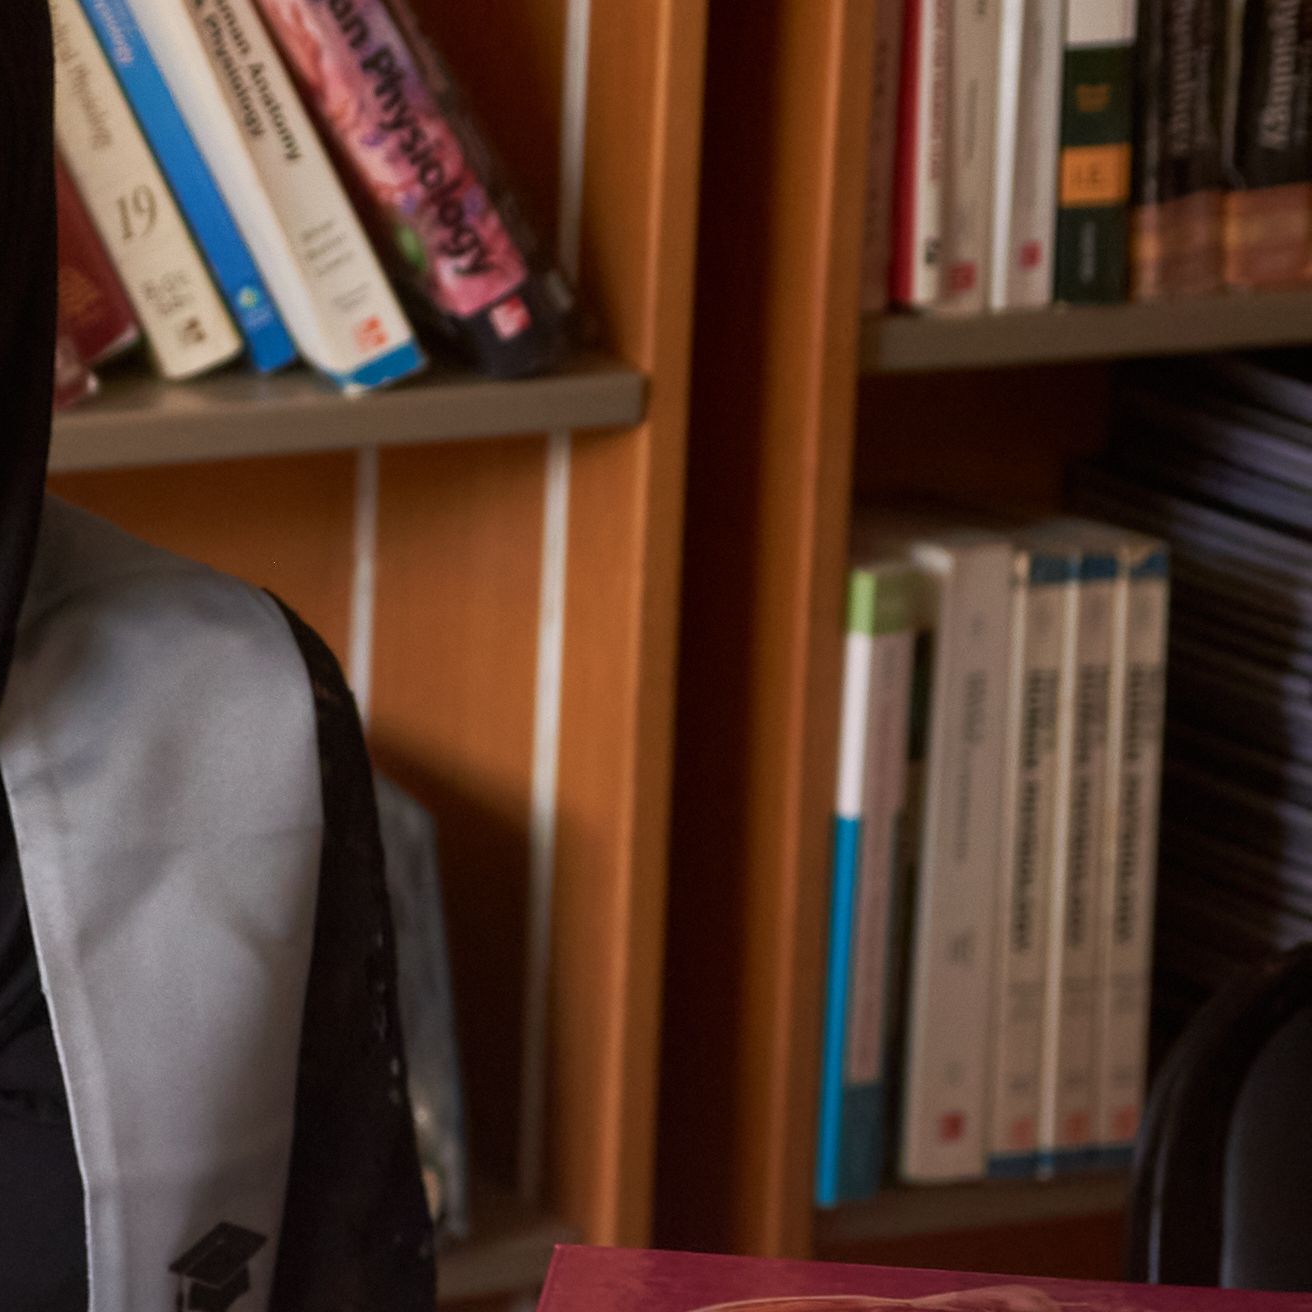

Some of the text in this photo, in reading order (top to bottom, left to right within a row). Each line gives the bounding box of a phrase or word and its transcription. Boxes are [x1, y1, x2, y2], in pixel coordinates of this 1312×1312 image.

[199, 15, 267, 137] Physiology
[247, 61, 304, 162] Anatomy
[115, 185, 159, 241] 19
[361, 48, 496, 278] Physiology
